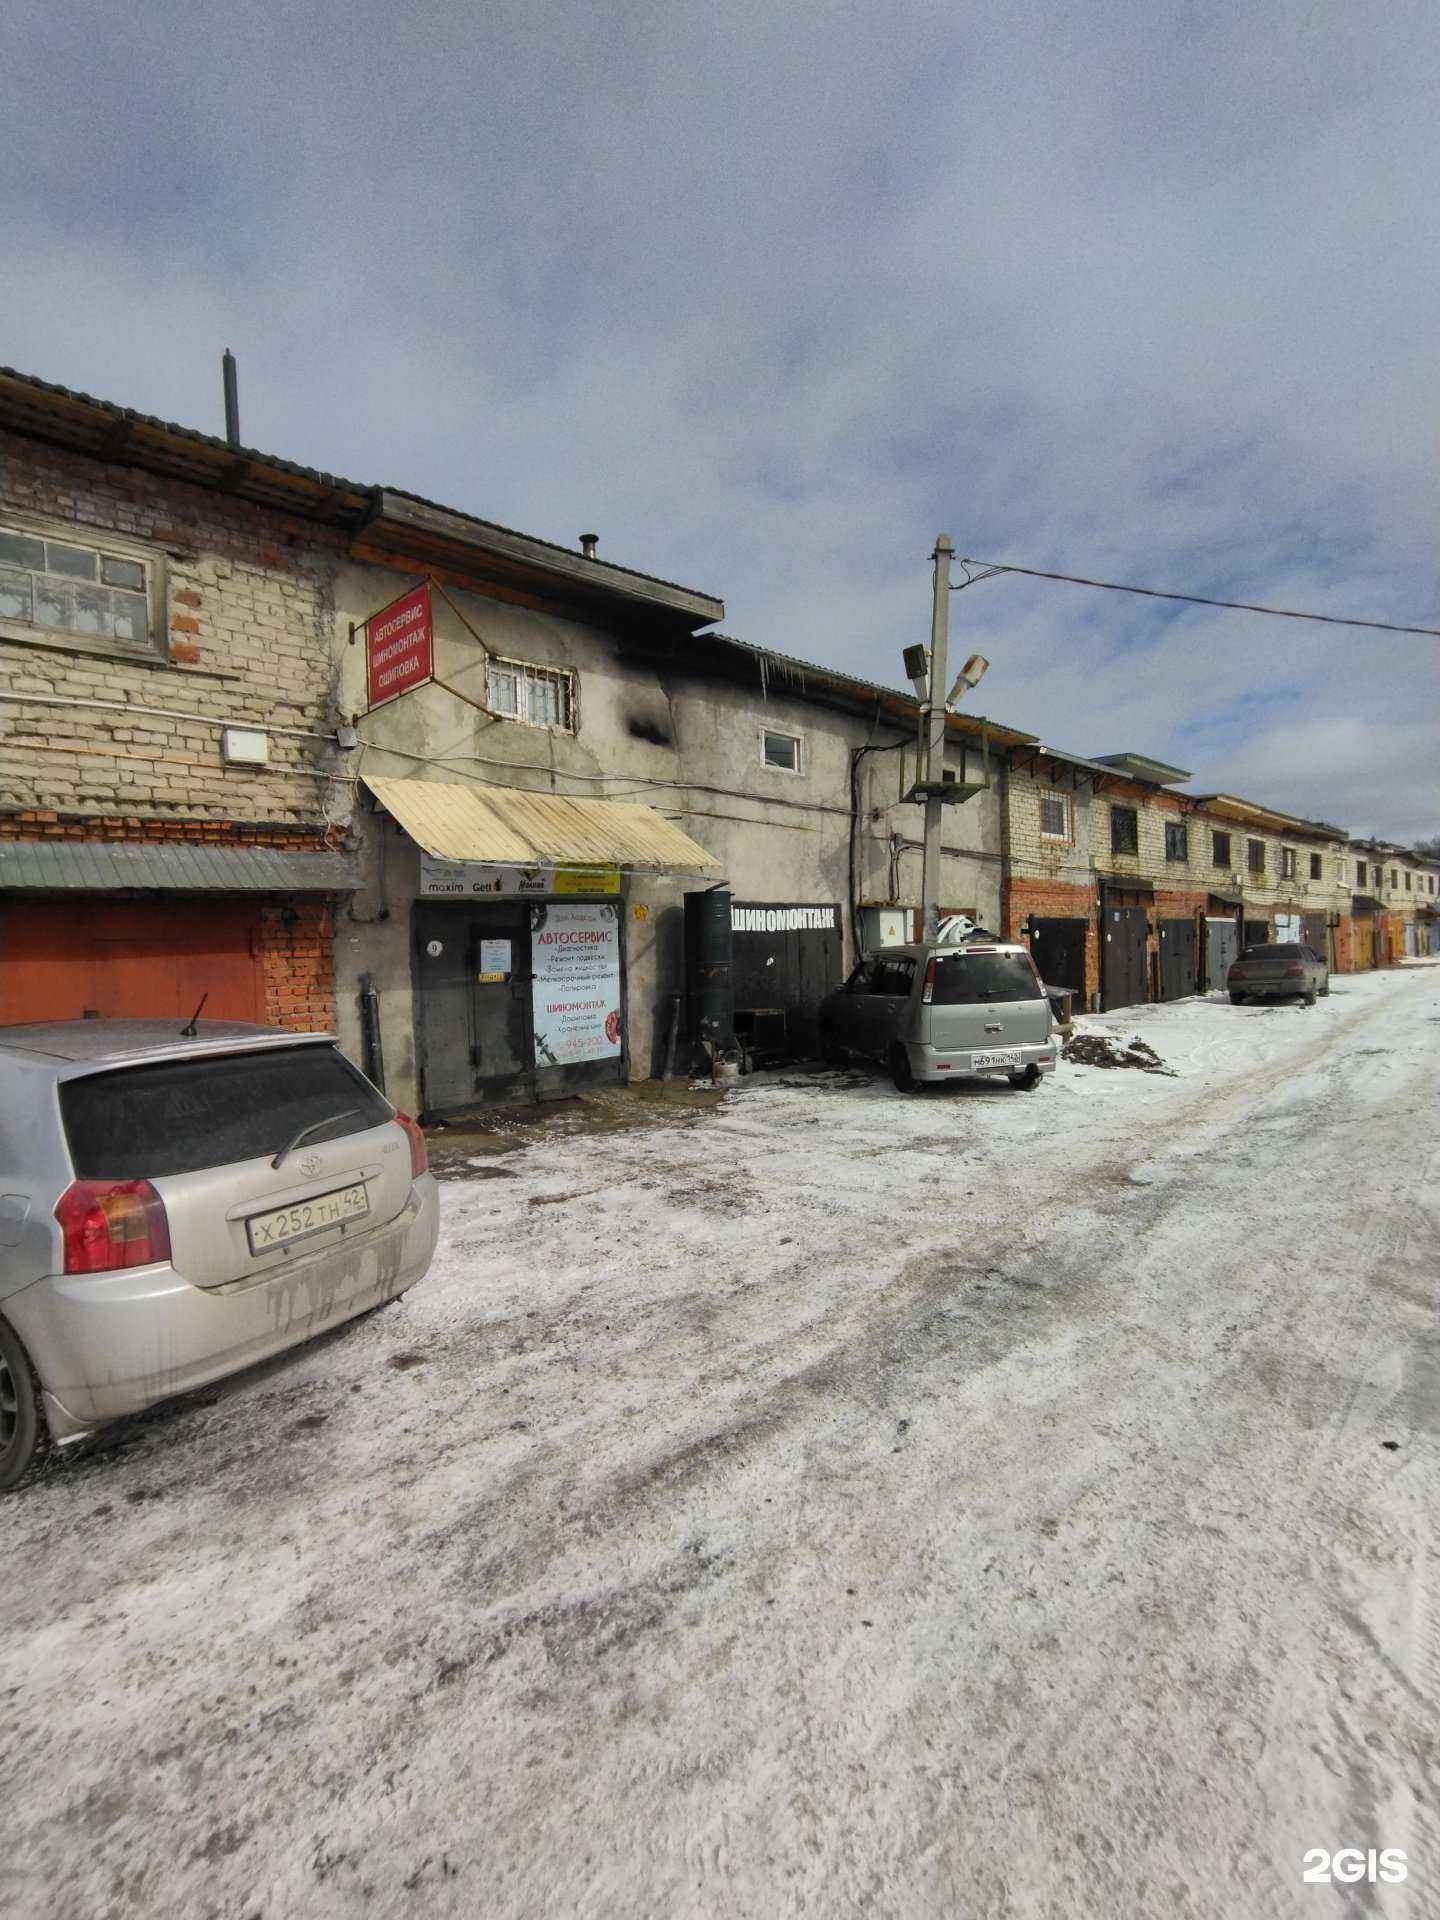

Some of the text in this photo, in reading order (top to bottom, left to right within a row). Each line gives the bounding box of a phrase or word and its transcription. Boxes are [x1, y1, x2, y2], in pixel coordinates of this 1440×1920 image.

[374, 603, 424, 643] АВТОСЕРВИС
[372, 626, 426, 669] ШИНОМОНТАЖ
[428, 882, 464, 892] maxim
[729, 905, 835, 932] ШИНОМОНТАЖ
[538, 931, 613, 945] АВТОСЕРВИС
[547, 1000, 607, 1014] ШИНОМОНТАЖ
